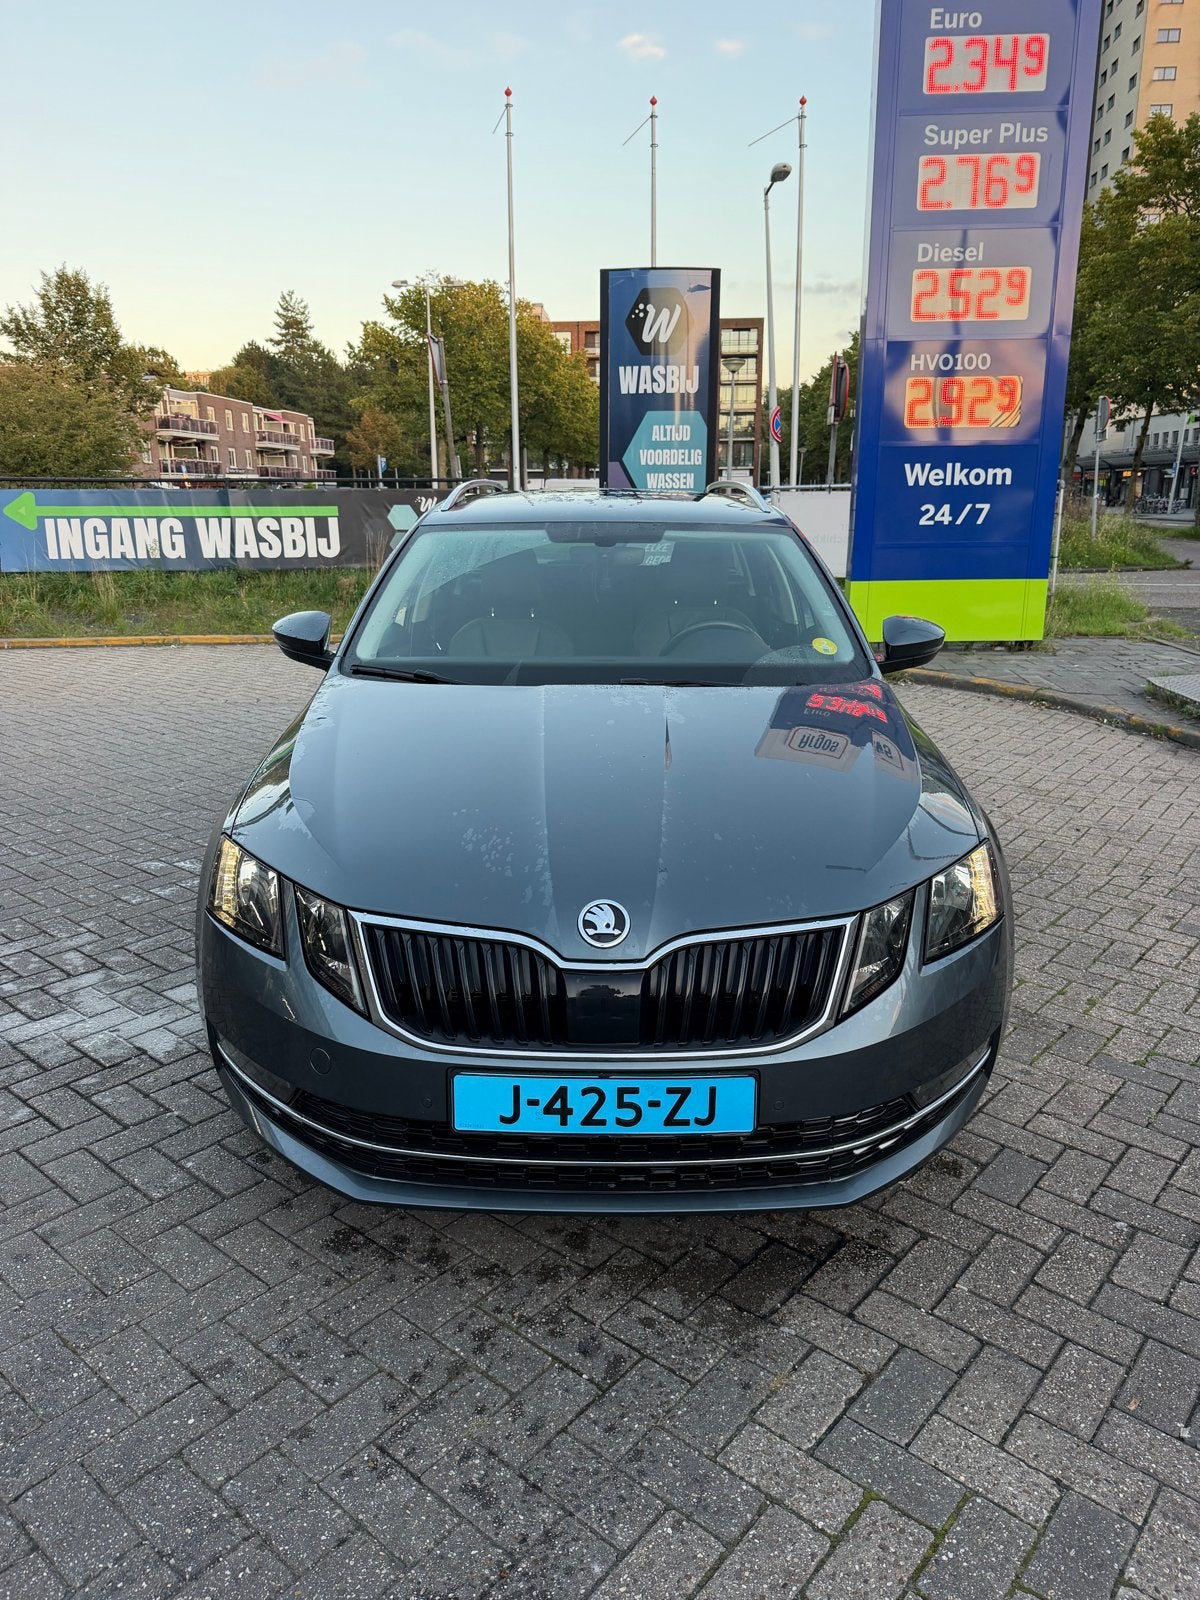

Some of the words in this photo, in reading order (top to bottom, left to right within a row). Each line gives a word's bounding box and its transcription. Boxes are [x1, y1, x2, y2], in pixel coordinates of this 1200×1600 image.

[930, 8, 982, 29] Euro
[926, 35, 1045, 94] 2.349
[924, 124, 992, 149] Super
[999, 122, 1048, 144] Plus
[920, 154, 1037, 210] 2.769
[917, 242, 984, 263] Diesel
[913, 268, 1027, 320] 2.529
[910, 353, 991, 371] HVO100
[618, 365, 699, 394] WASBIJ
[907, 377, 1019, 426] 2.929
[651, 425, 691, 441] ALTIJD
[639, 449, 702, 466] VOORDELIG
[646, 472, 695, 489] WASSEN
[904, 462, 1012, 487] Welkom
[918, 503, 991, 526] 24/7
[45, 517, 187, 560] INGANG
[198, 517, 341, 559] WASBIJ
[499, 1084, 717, 1127] J-425-ZJ
